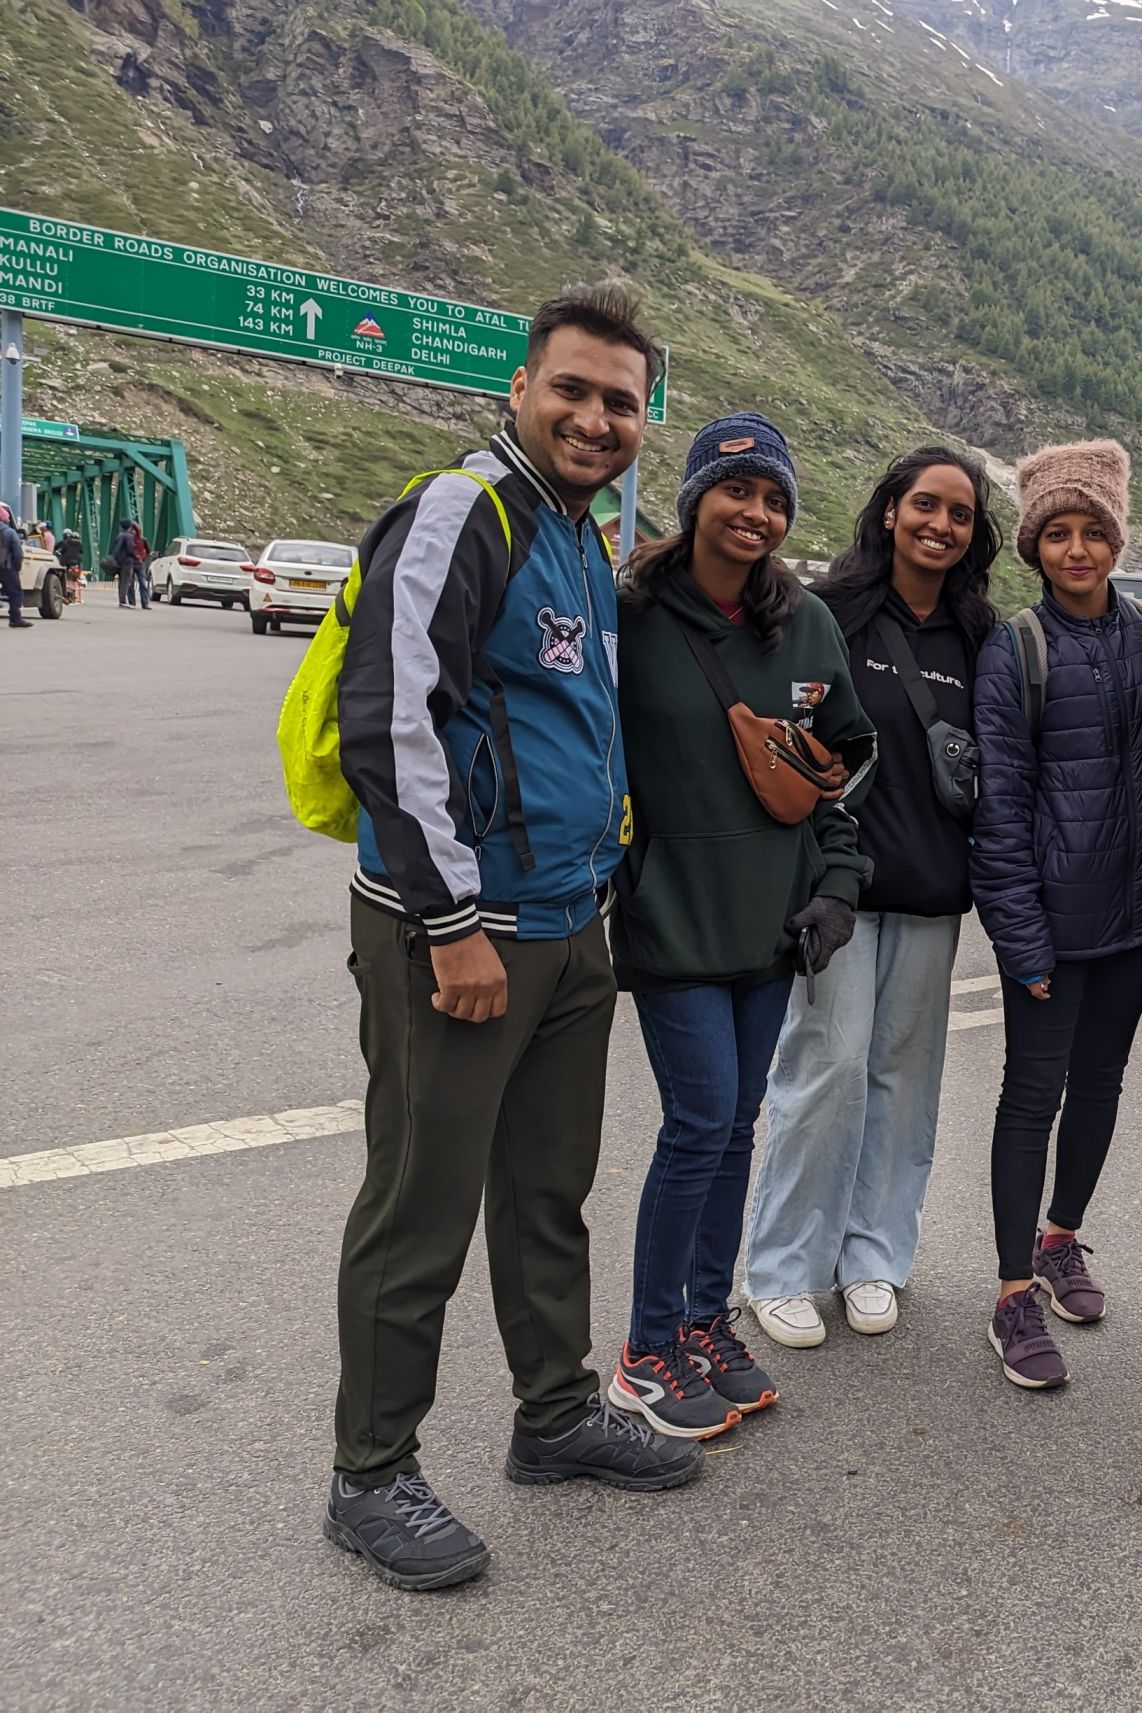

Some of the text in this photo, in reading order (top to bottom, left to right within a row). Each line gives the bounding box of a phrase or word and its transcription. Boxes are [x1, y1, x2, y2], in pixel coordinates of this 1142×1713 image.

[0, 235, 73, 262] MANALI
[0, 253, 58, 276] KULLU
[30, 219, 105, 247] BORDER
[114, 237, 174, 260] ROADS
[183, 251, 306, 287] ORGANISATION
[316, 277, 399, 305] WELCOMES
[408, 296, 437, 313] YOU
[446, 304, 465, 318] TO
[475, 311, 507, 328] ATAL
[0, 271, 62, 294] MANDI
[22, 297, 56, 311] BRTF
[246, 284, 294, 304] 33 KM
[244, 300, 293, 320] 74 KM
[238, 316, 293, 336] 143 KM
[412, 317, 466, 338] SHIMLA
[356, 340, 382, 353] NH-3
[411, 332, 507, 361] CHANDIGARH
[411, 348, 450, 365] DELHI
[318, 349, 415, 375] PROJECT DEEPAK
[866, 658, 889, 671] For
